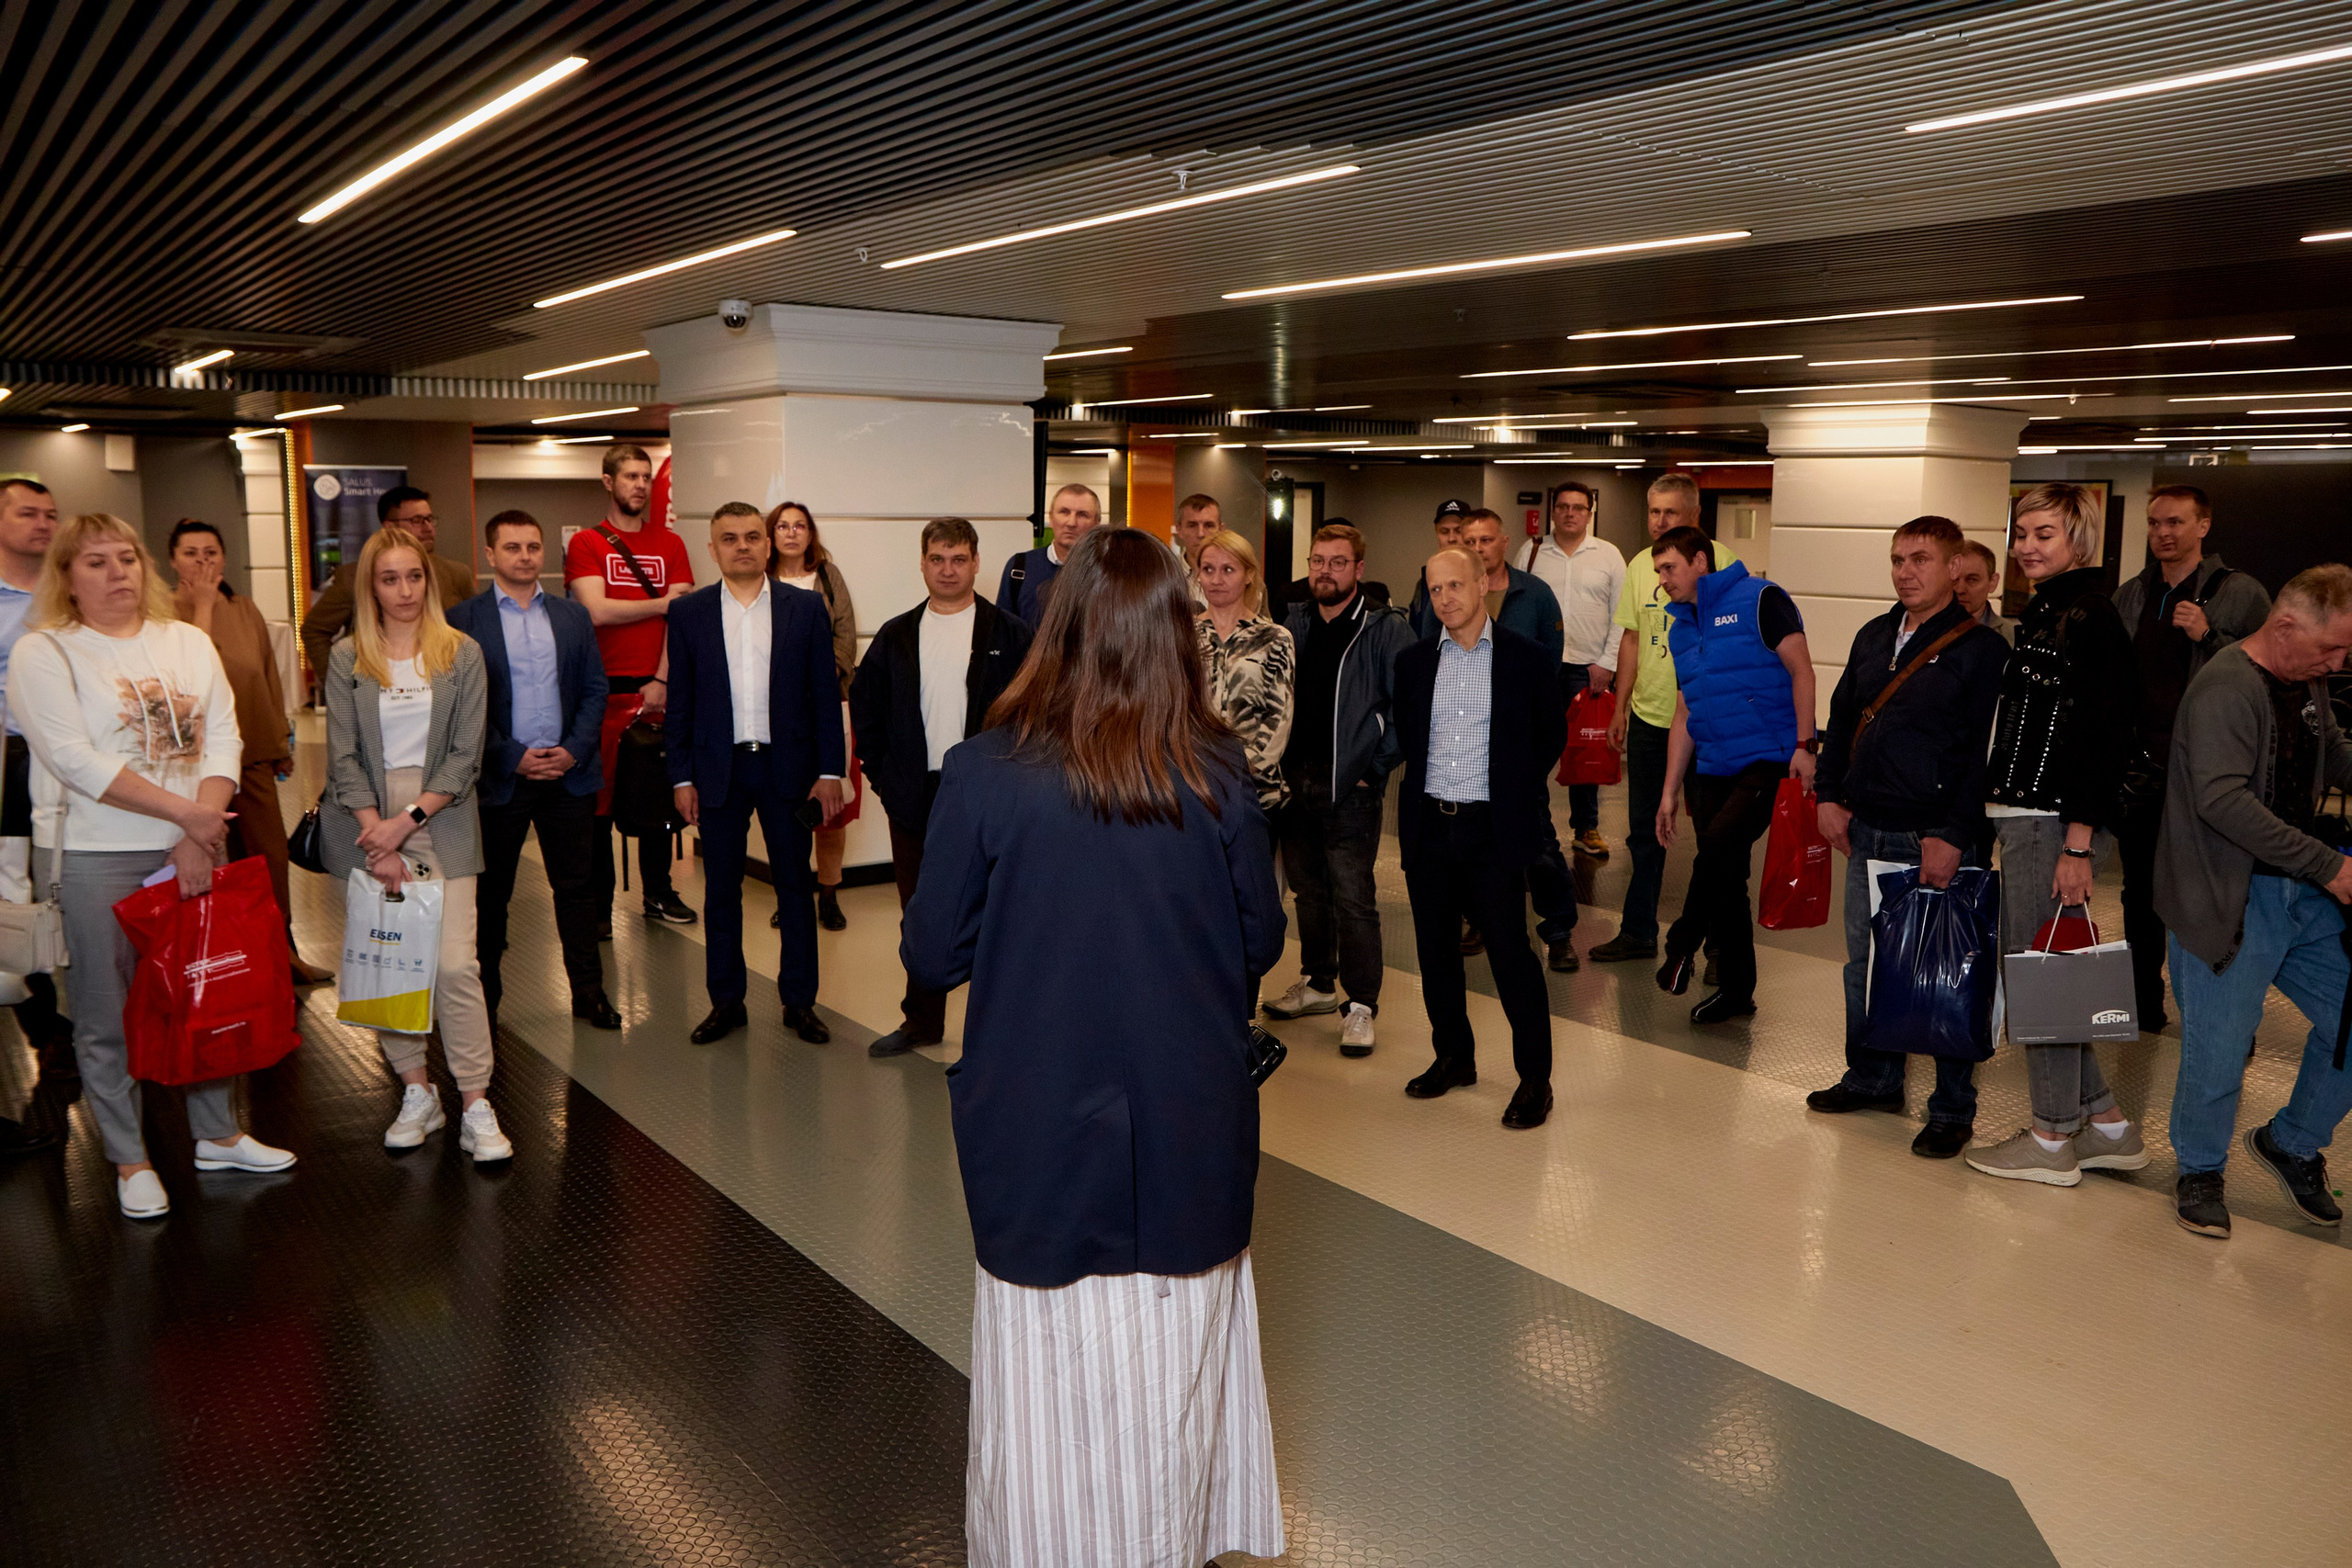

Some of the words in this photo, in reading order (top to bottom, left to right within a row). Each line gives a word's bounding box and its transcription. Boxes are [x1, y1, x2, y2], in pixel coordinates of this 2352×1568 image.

[343, 487, 371, 496] Smart
[1714, 614, 1738, 626] BAXI
[369, 929, 401, 942] EISEN
[2091, 1010, 2131, 1024] KERMI
